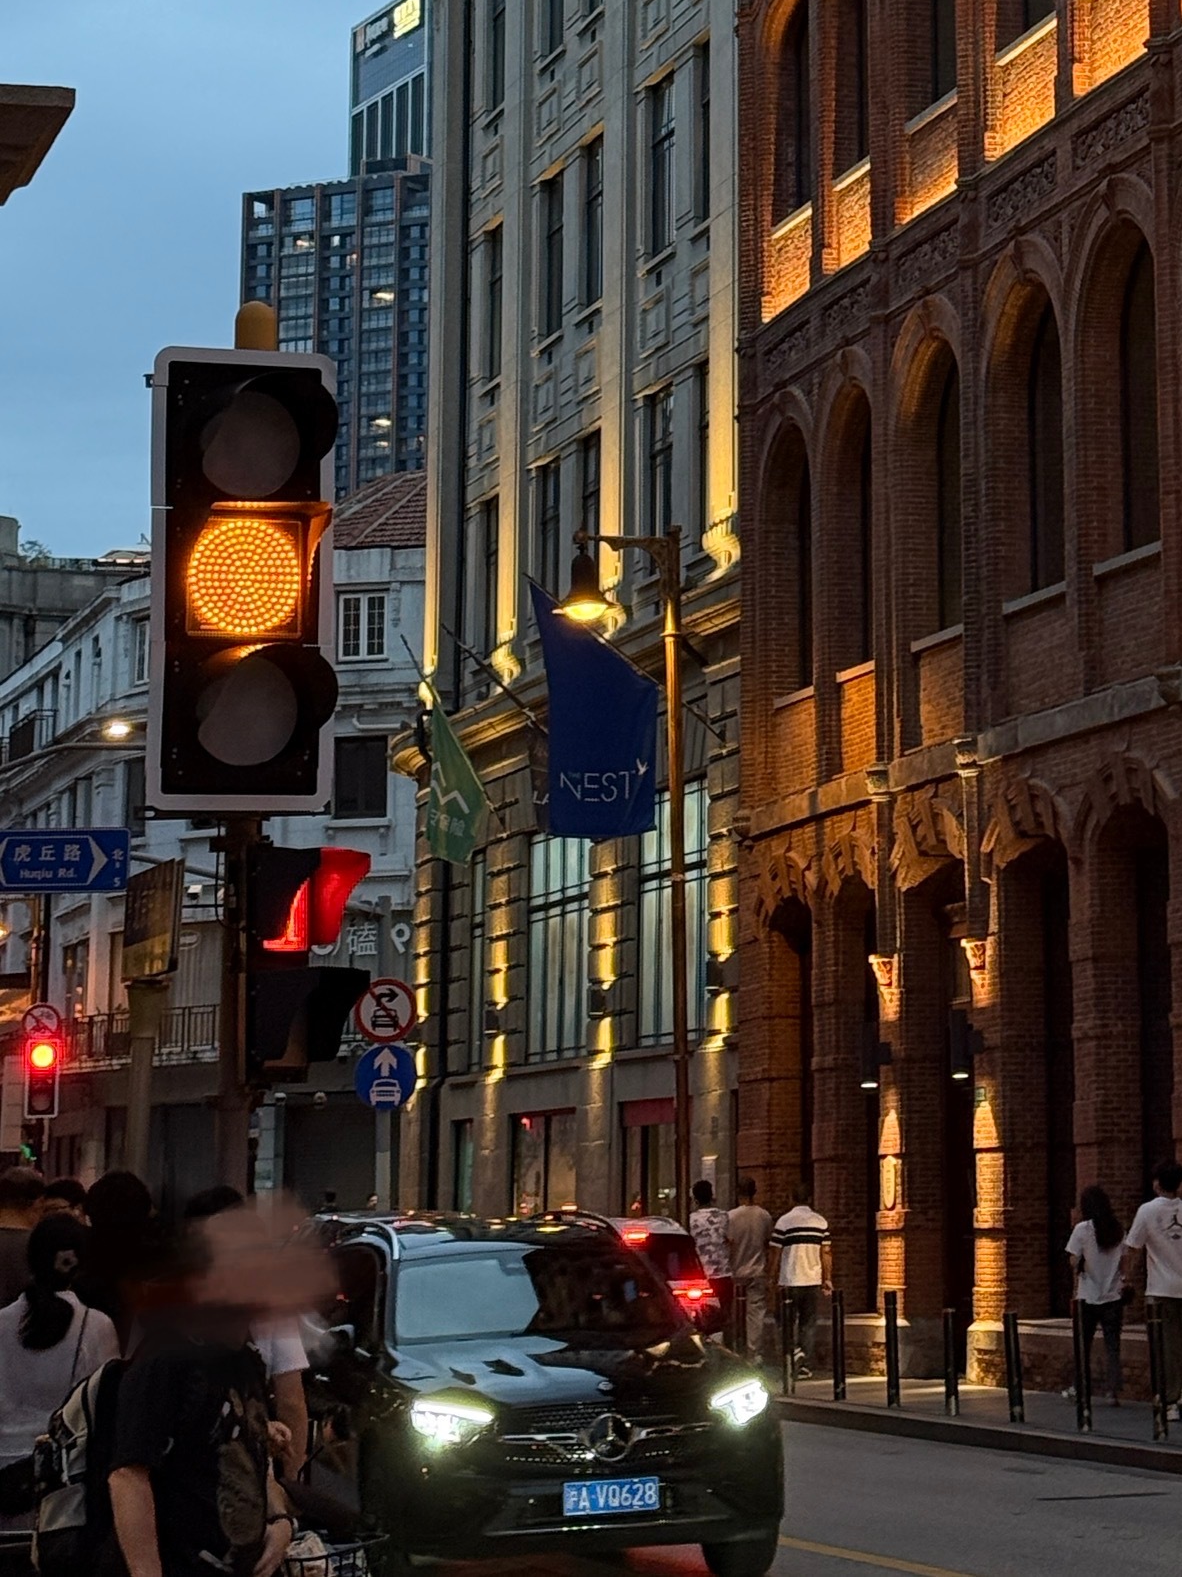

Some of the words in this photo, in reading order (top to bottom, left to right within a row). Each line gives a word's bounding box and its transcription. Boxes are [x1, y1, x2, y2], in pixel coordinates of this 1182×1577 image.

[560, 771, 630, 801] NEST
[13, 844, 81, 862] 虎丘路
[20, 868, 53, 880] Huqiu
[58, 867, 77, 878] Rd.
